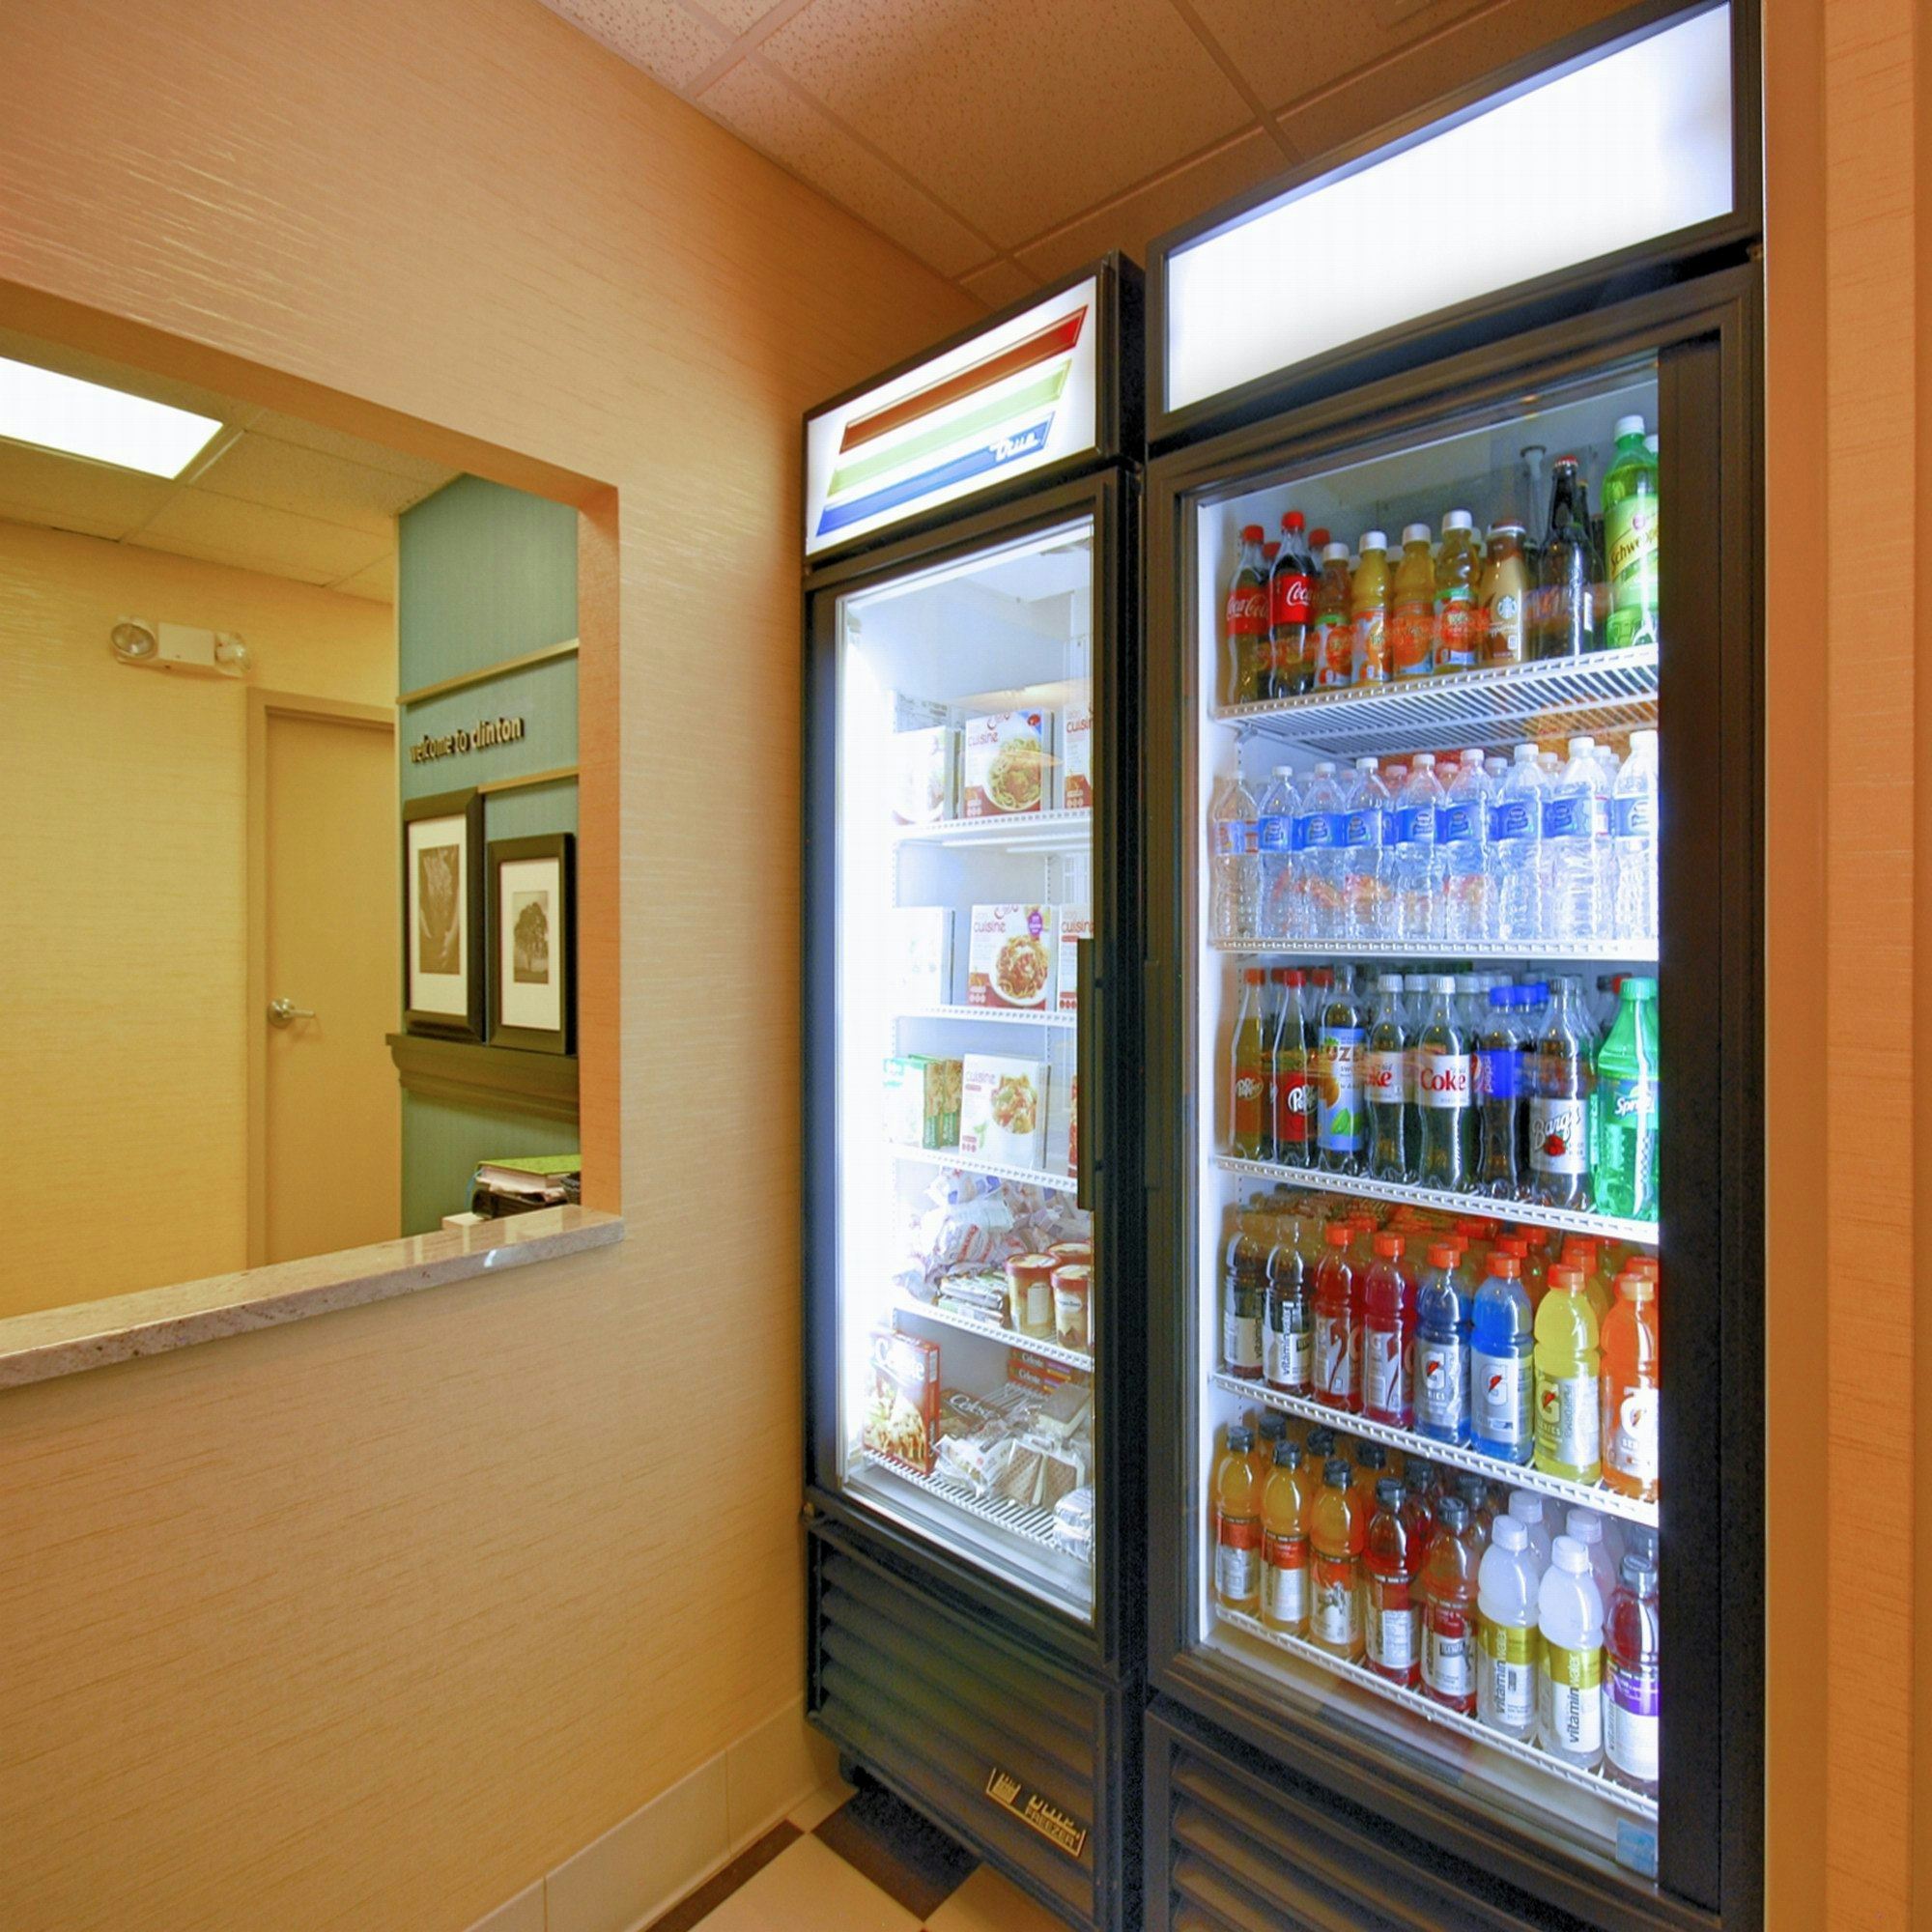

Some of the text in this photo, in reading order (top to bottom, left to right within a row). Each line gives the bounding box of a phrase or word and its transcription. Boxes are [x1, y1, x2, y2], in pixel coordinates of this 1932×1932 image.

[411, 717, 525, 763] welcome to clinton
[1421, 1067, 1466, 1092] Coke
[1567, 1652, 1579, 1743] vitaminwater
